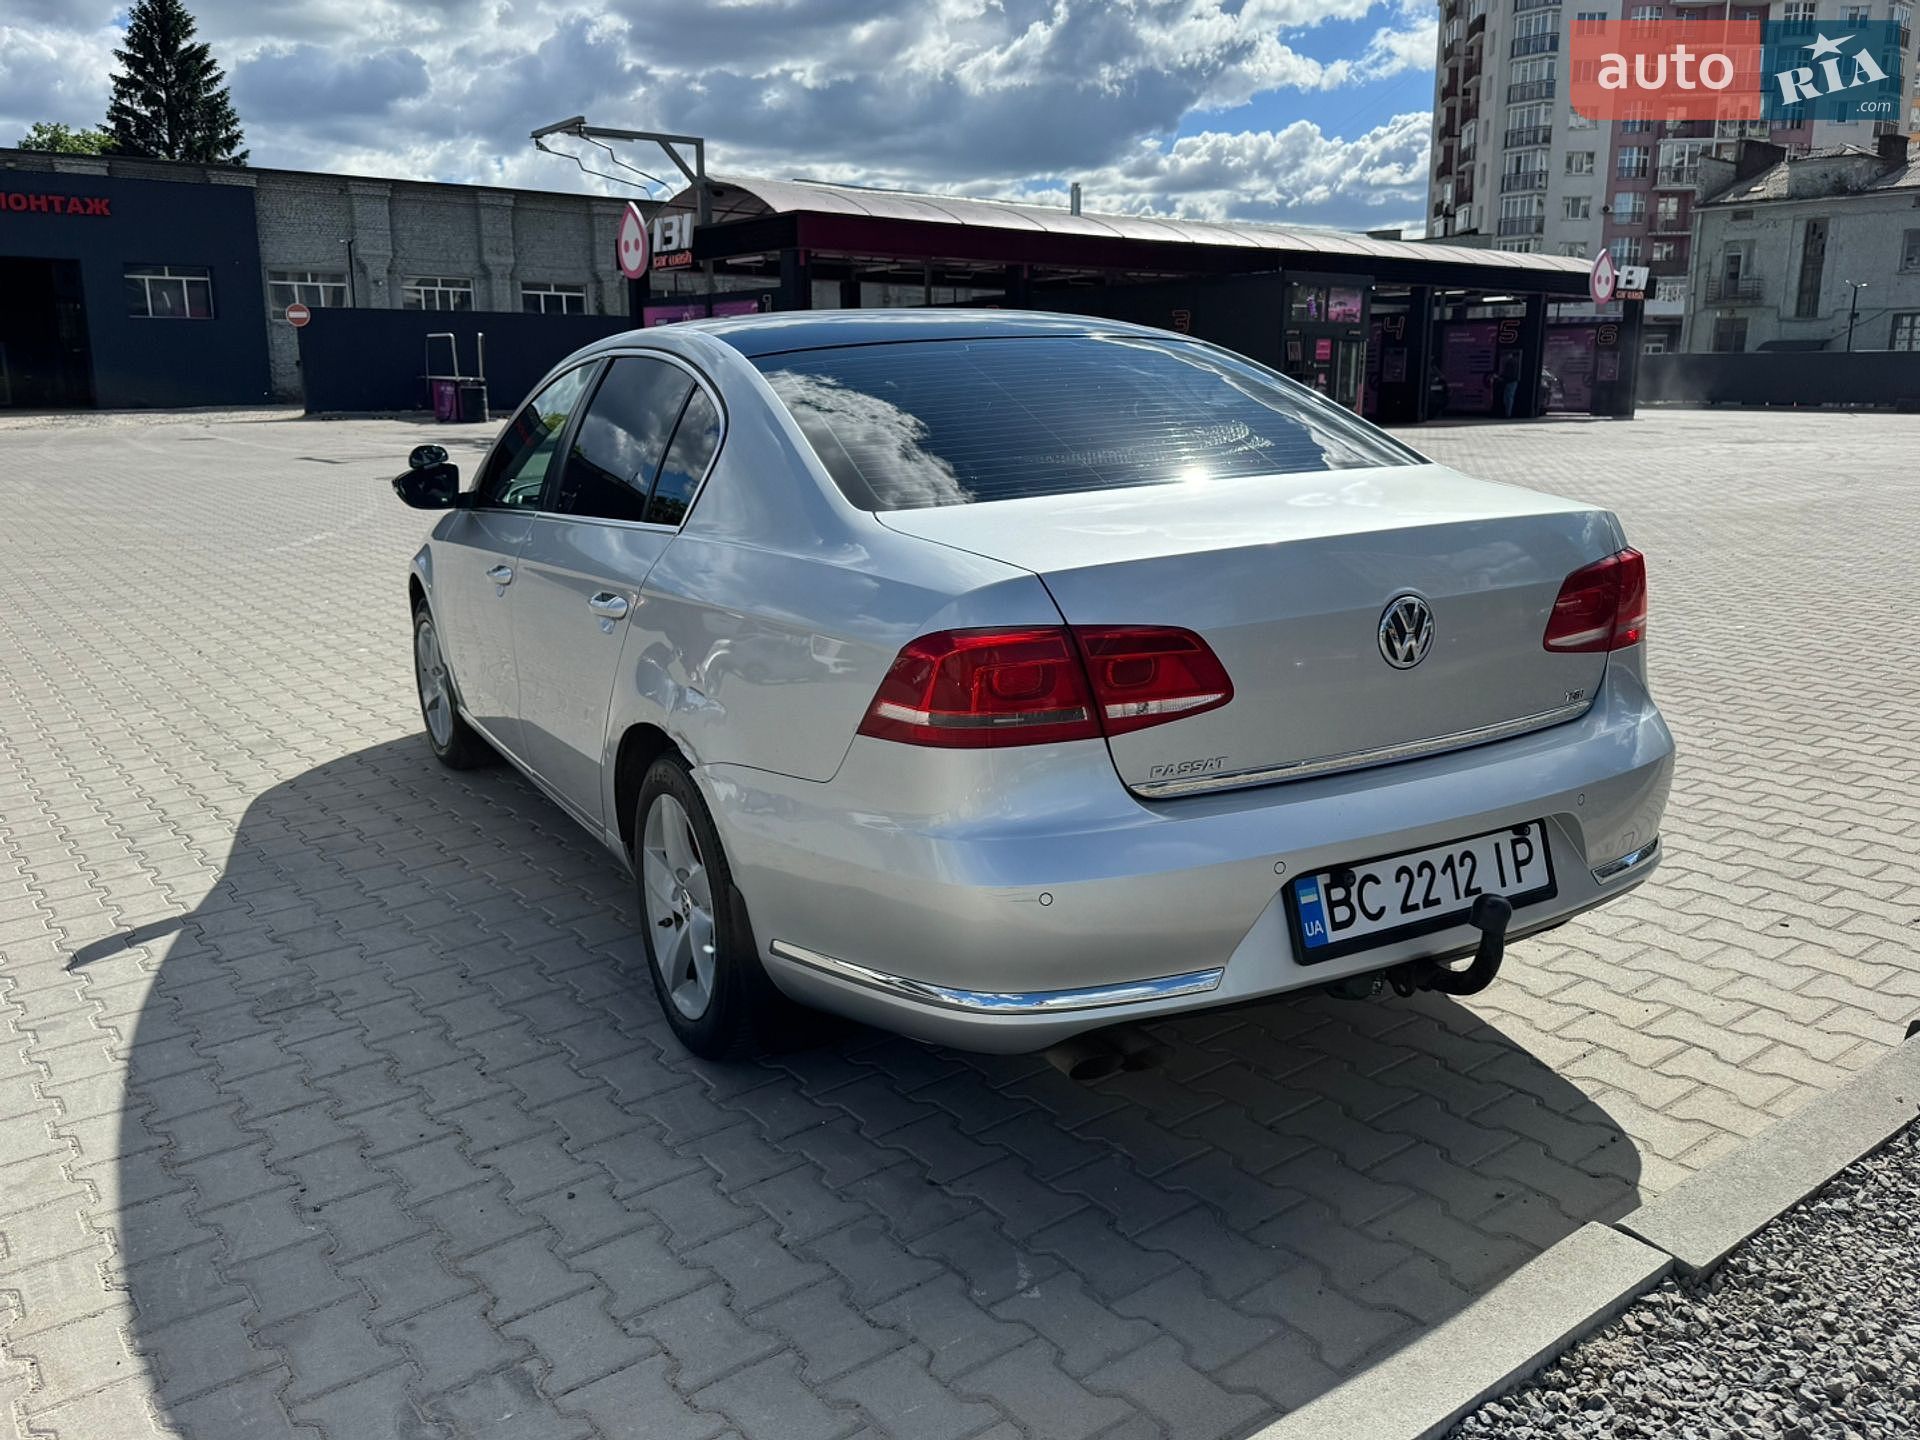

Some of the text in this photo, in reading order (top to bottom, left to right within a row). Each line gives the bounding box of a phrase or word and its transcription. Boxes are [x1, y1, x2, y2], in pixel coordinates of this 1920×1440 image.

[1384, 315, 1406, 340] 4
[1499, 319, 1521, 343] 5
[1597, 324, 1618, 345] 6
[1149, 755, 1229, 779] PASSAT
[1323, 837, 1534, 932] BC 2212 IP
[1305, 921, 1324, 937] UA
